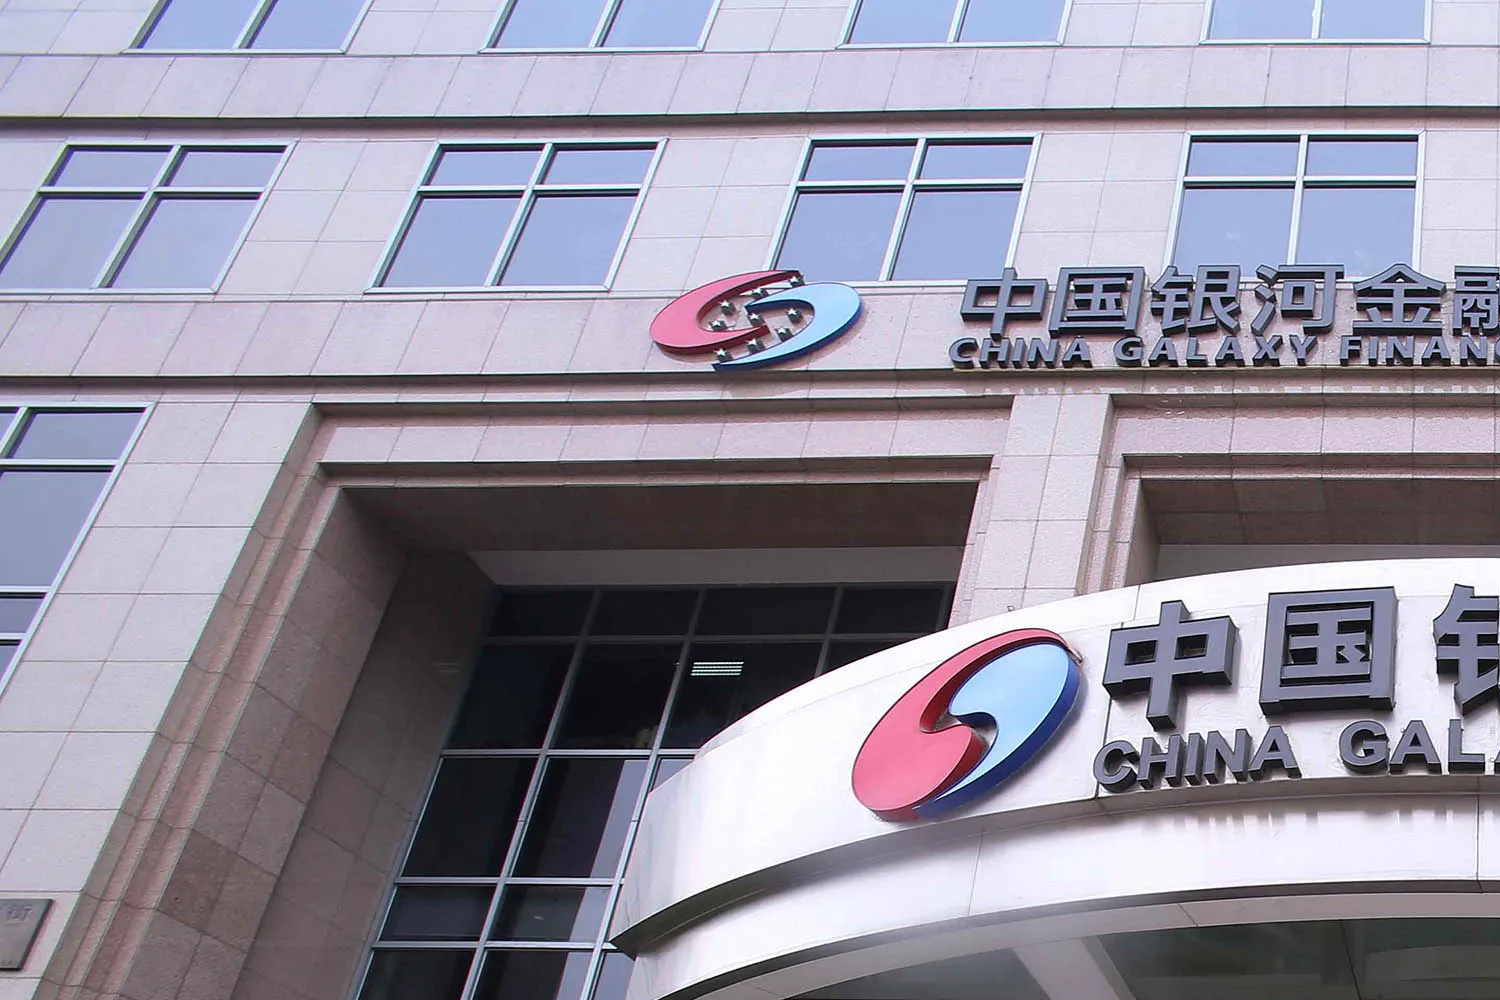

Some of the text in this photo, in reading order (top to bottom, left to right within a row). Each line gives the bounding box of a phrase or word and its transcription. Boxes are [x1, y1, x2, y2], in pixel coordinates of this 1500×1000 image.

[950, 335, 1093, 370] CHINA
[1112, 335, 1317, 369] GALAXY
[1093, 725, 1302, 792] CHINA
